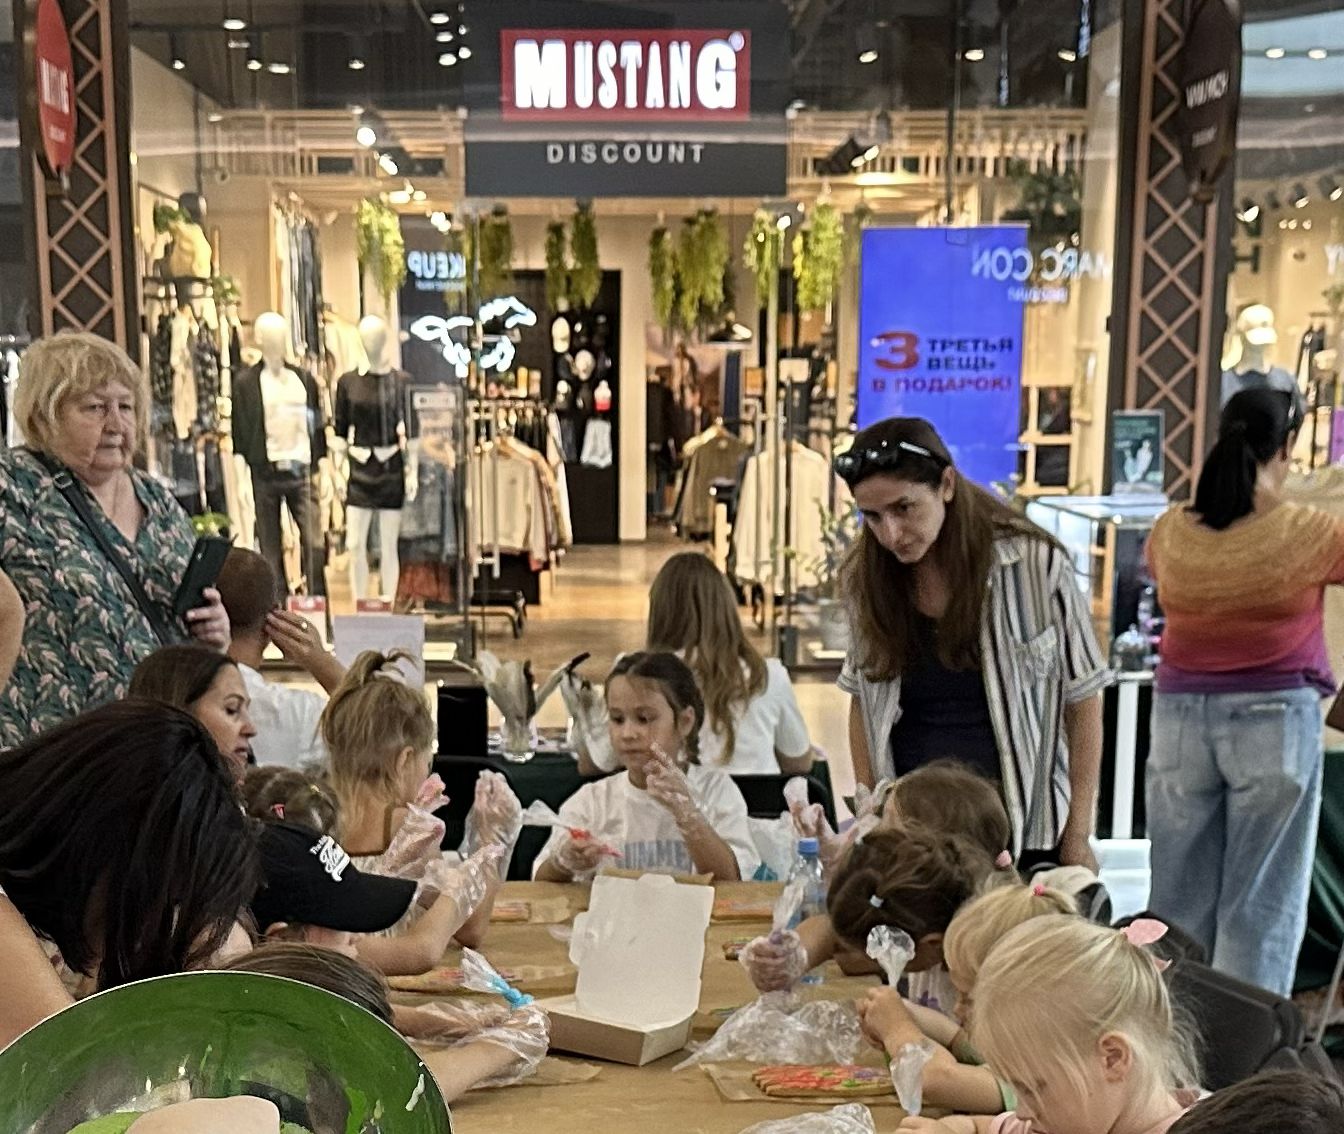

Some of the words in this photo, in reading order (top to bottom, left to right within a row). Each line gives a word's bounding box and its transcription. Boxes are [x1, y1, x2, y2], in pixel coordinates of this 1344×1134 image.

[546, 142, 705, 164] DISCOUNT
[927, 338, 1013, 353] ТРЕТЬЯ
[895, 376, 1012, 394] ПОДАРОК!
